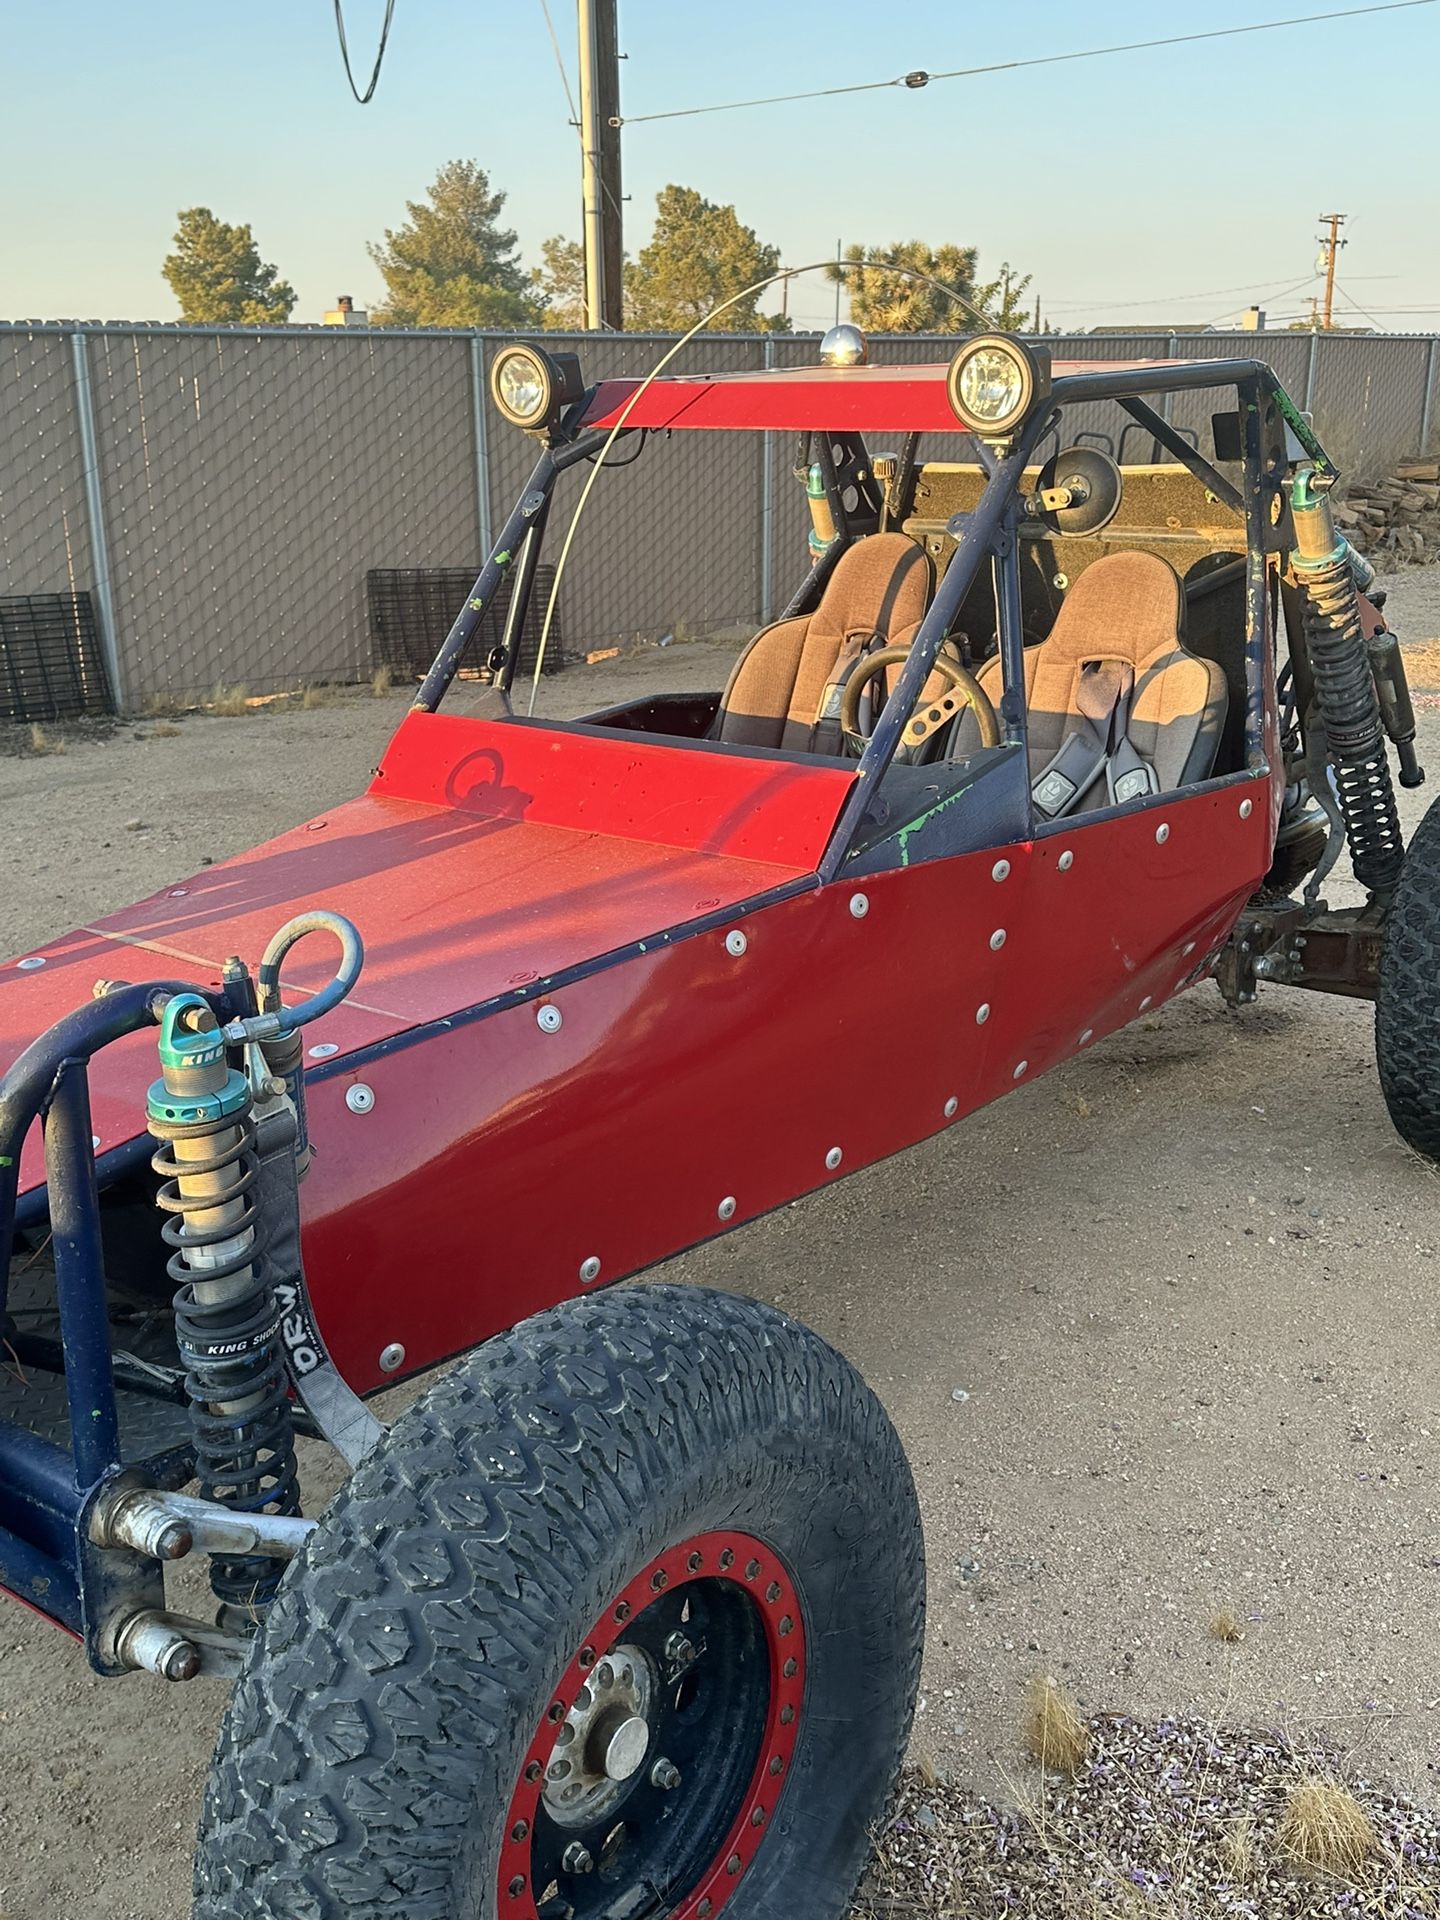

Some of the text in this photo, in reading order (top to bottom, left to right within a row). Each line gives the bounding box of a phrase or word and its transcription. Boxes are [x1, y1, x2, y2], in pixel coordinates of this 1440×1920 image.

[181, 1045, 224, 1067] KING
[273, 1284, 318, 1374] ORW
[207, 1341, 248, 1355] KING
